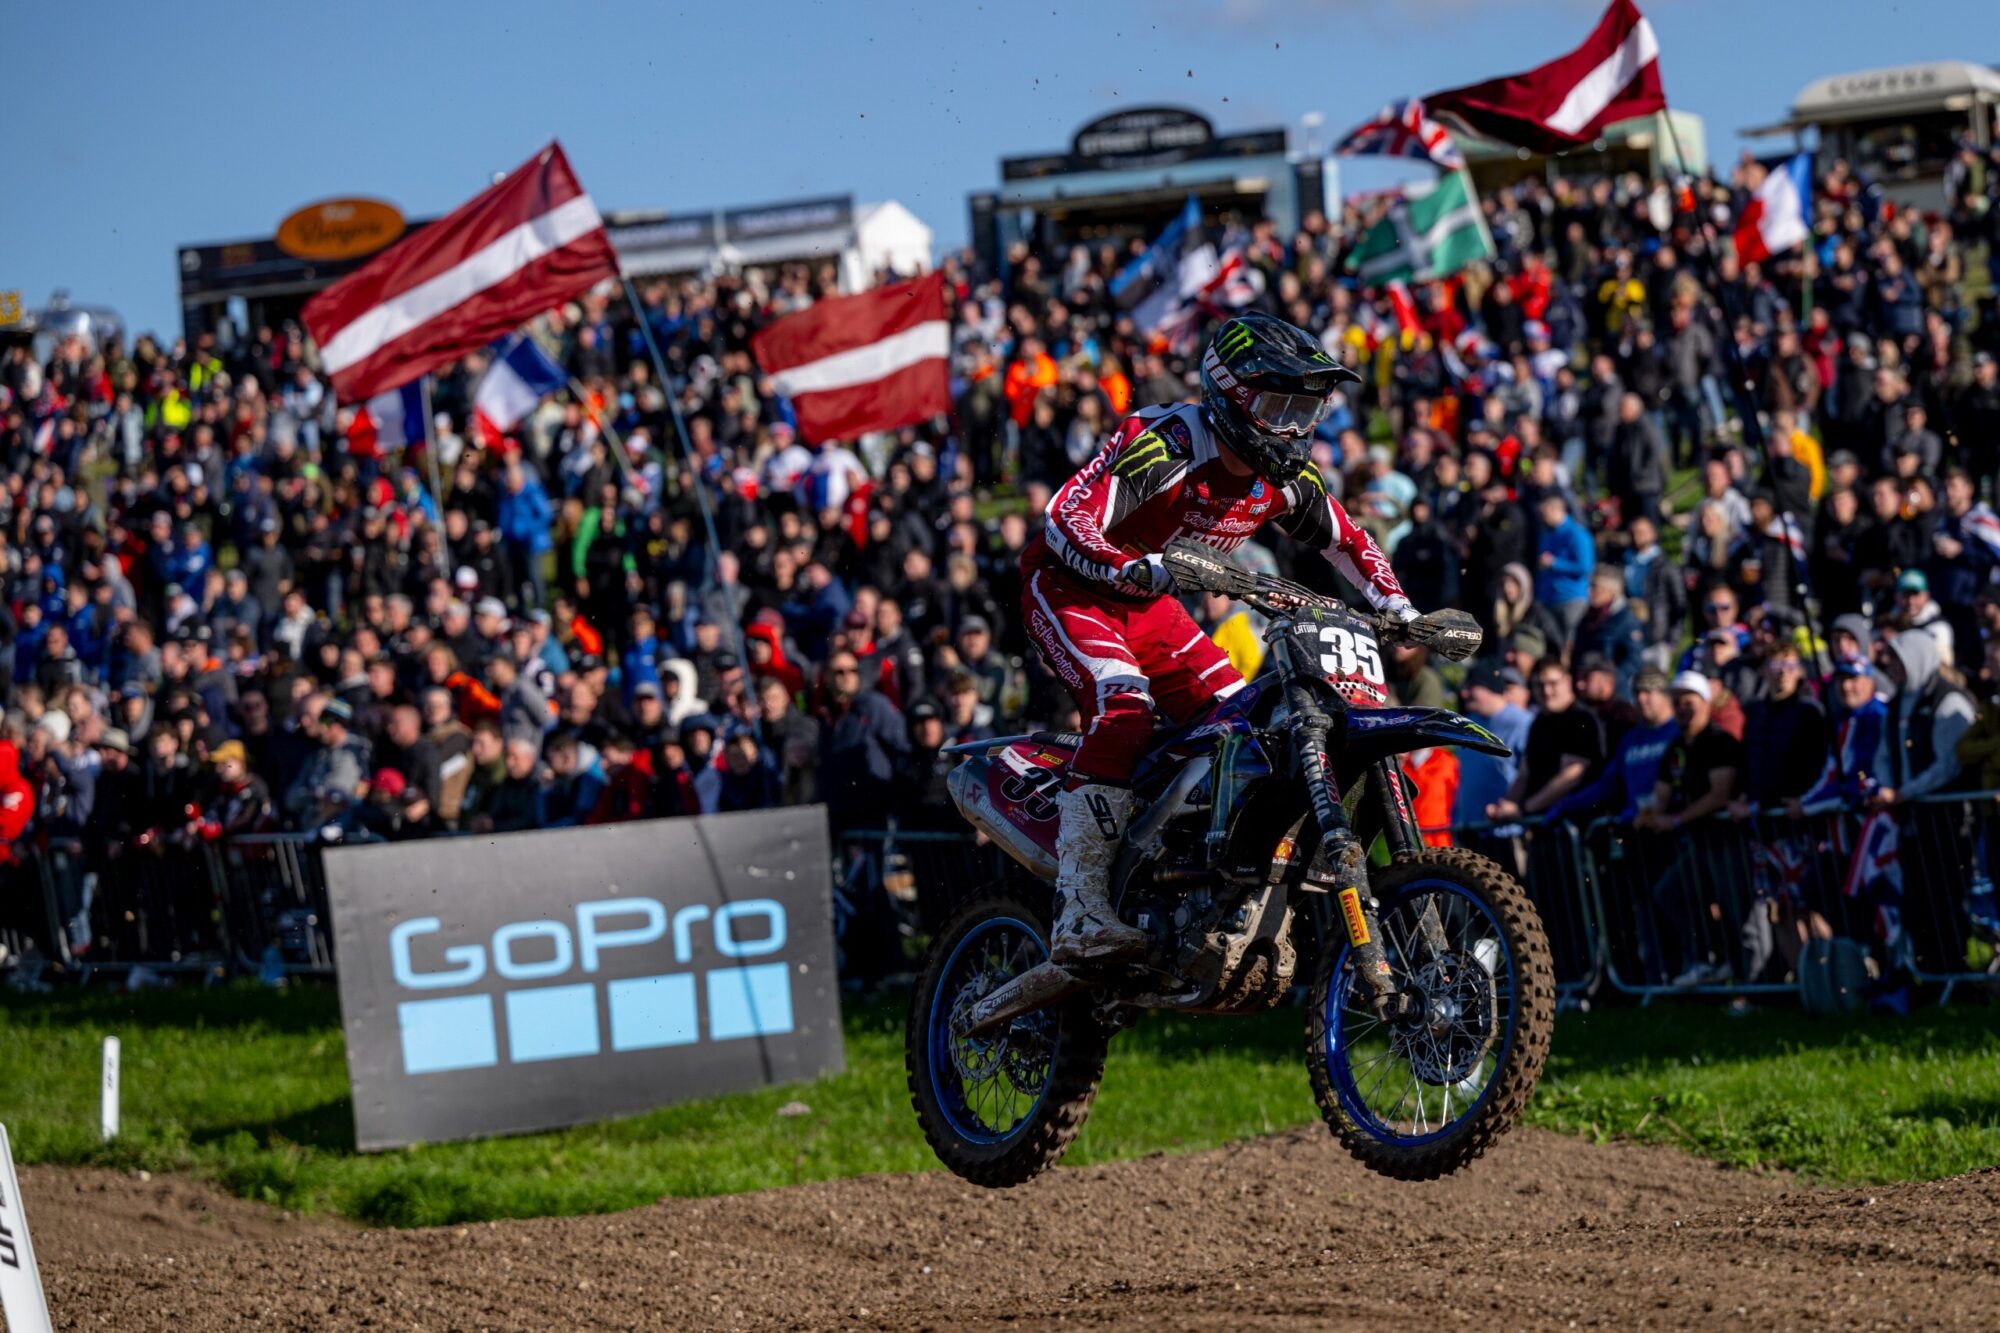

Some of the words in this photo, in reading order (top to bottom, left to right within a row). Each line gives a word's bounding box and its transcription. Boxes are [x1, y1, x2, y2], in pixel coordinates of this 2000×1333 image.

[1170, 551, 1225, 574] ACERBIS
[1320, 627, 1385, 685] 35
[1000, 766, 1061, 822] 35
[1300, 741, 1330, 823] YAMAHA
[389, 896, 788, 990] GoPro
[1343, 893, 1365, 941] PIRELLI
